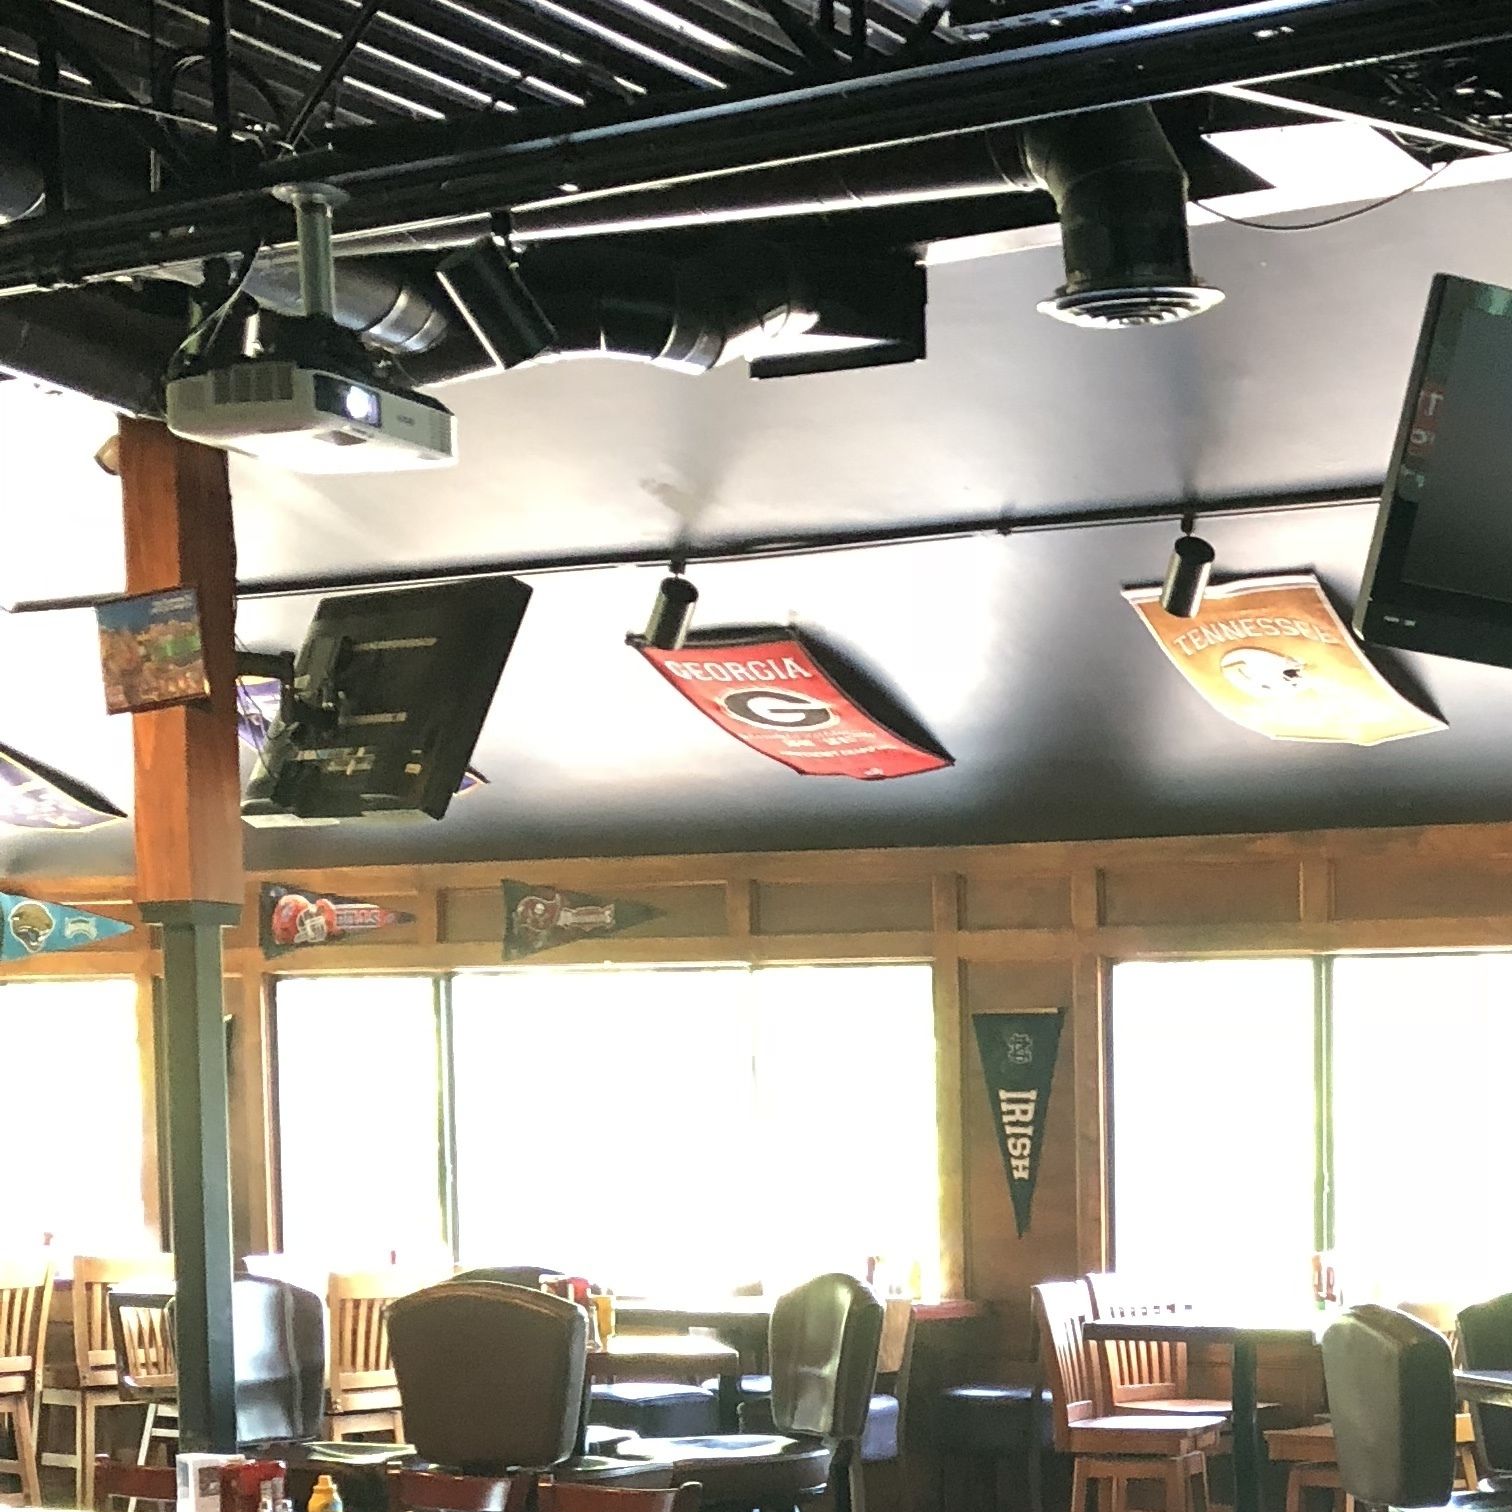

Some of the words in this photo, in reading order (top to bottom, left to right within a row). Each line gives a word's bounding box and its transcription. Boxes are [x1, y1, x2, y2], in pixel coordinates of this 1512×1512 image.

[1172, 616, 1342, 656] TENNESSEE
[662, 656, 813, 682] GEORGIA
[998, 1088, 1038, 1181] IRISH
